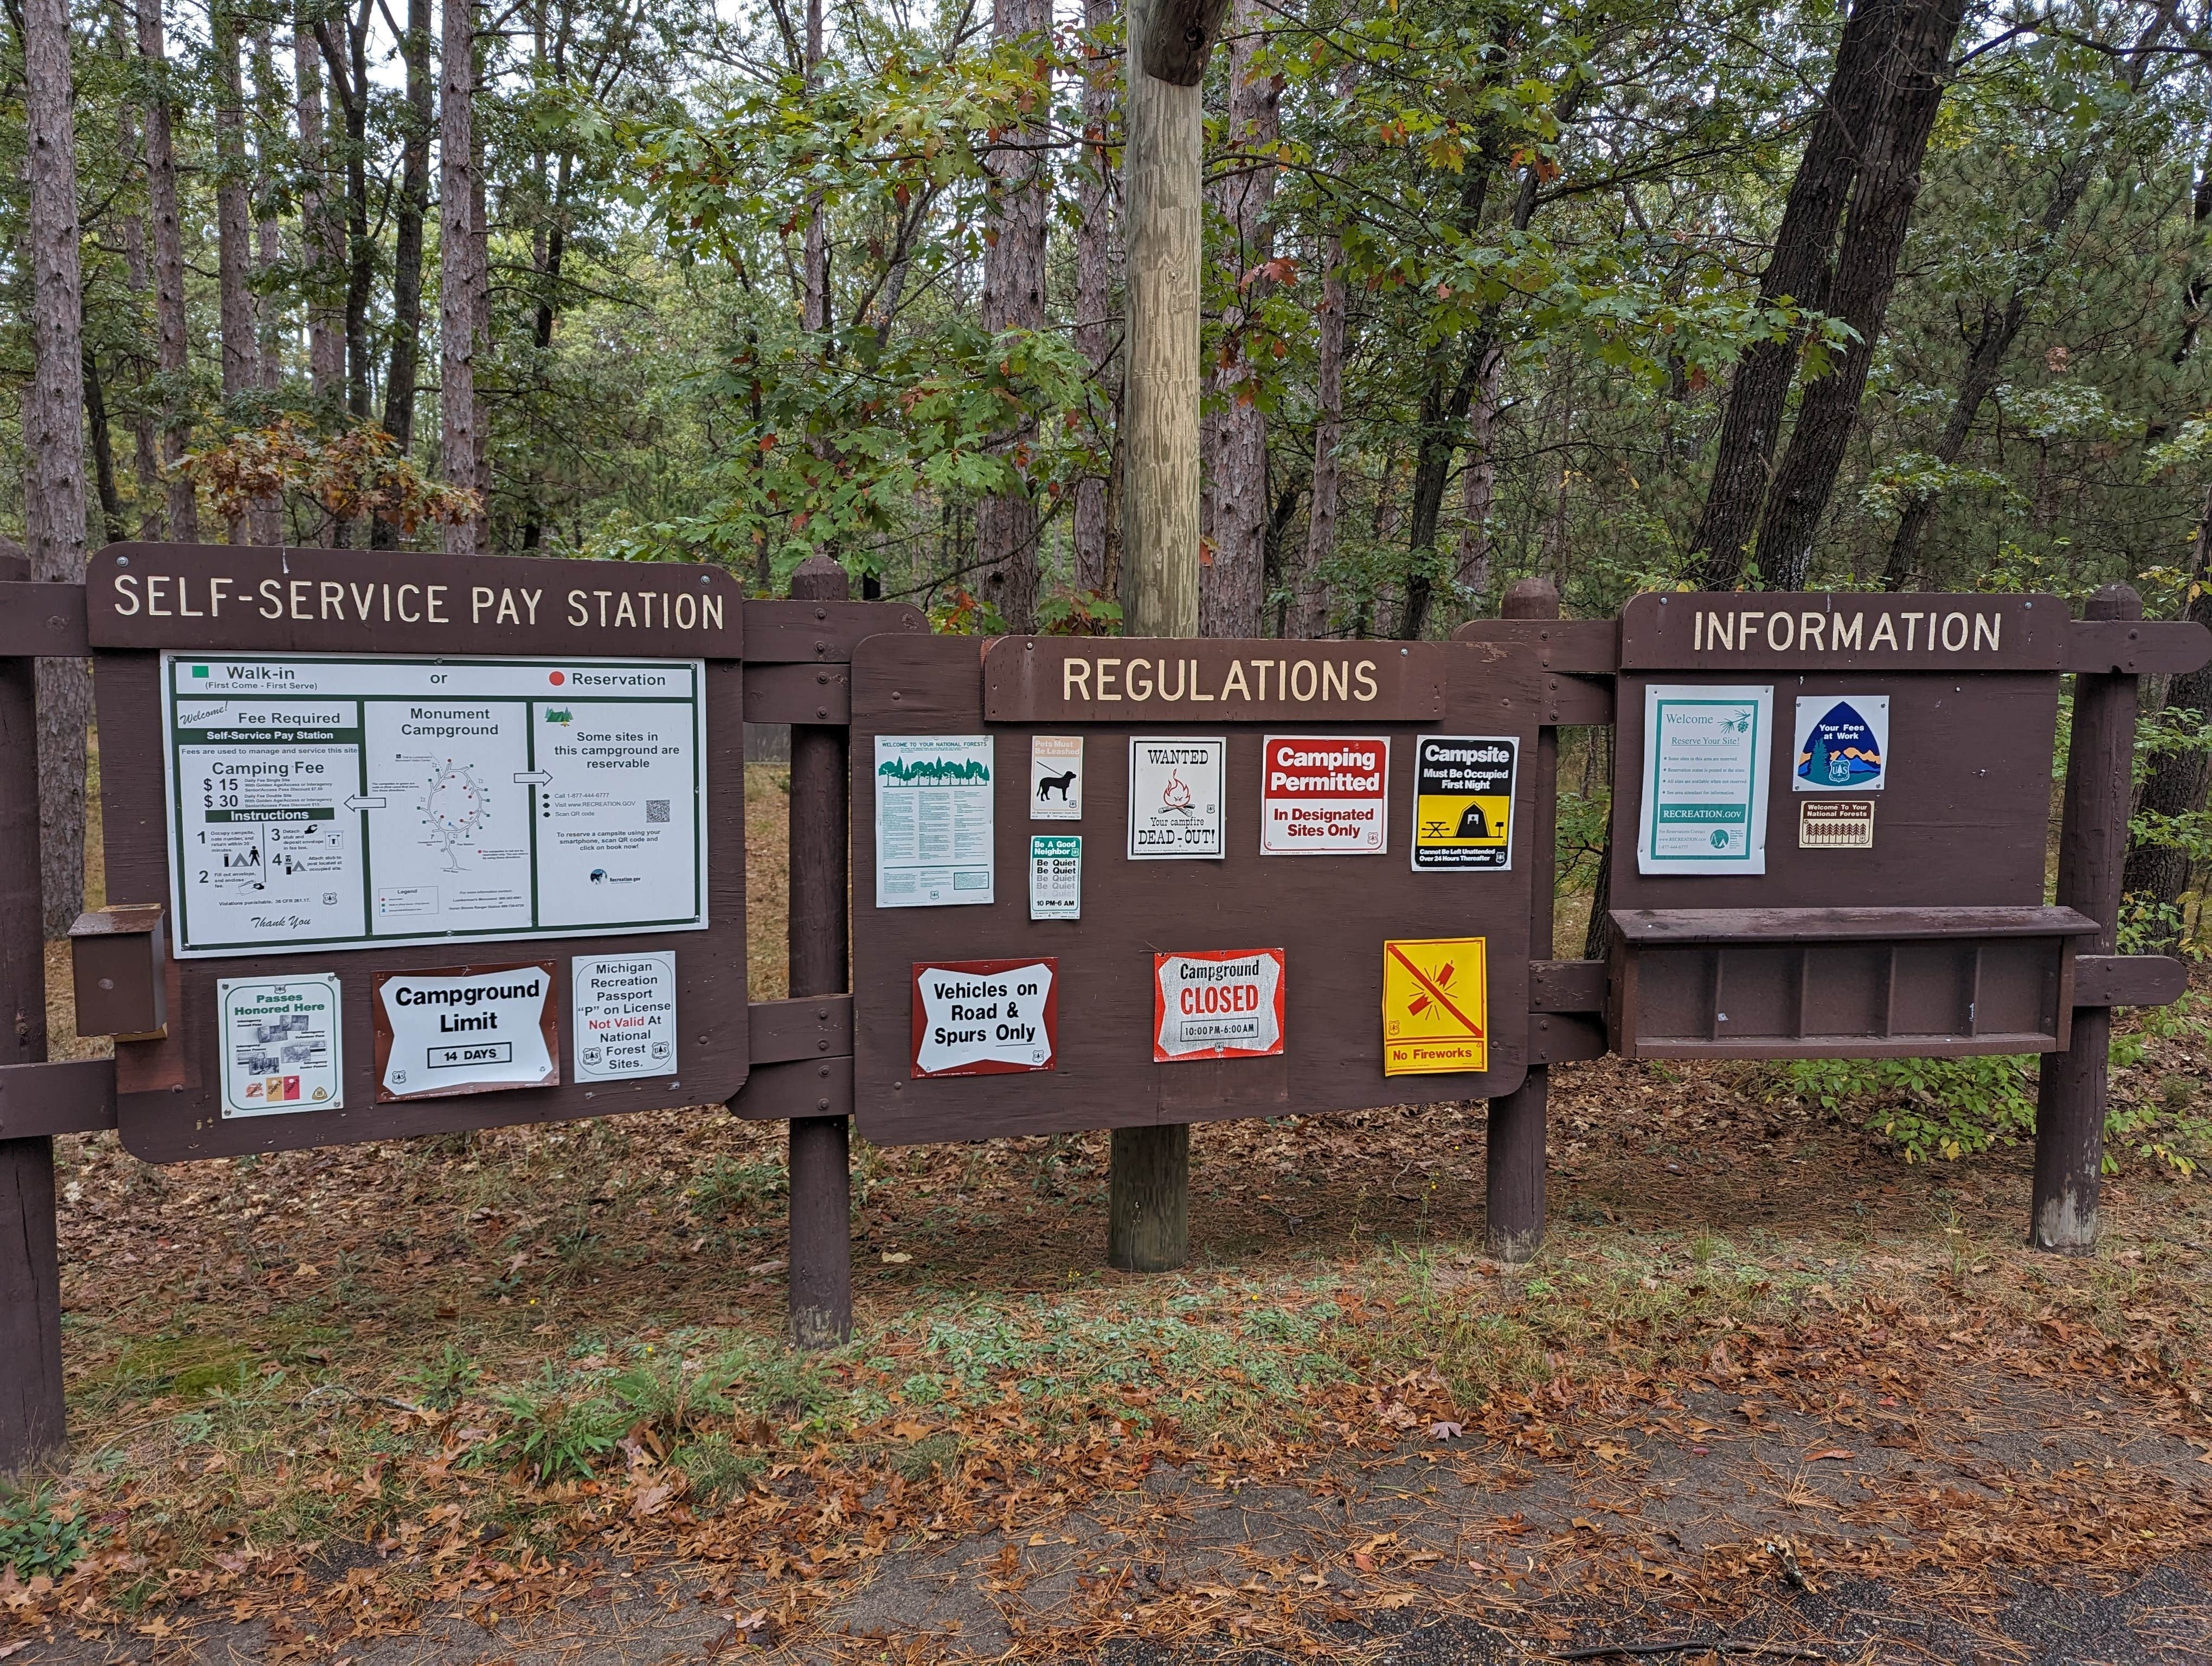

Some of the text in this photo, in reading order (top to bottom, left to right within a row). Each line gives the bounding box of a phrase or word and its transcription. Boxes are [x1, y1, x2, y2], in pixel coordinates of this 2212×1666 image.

[114, 574, 723, 629] SELF-SERVICE PAY STATION
[1695, 611, 2001, 651] INFORMATION
[227, 666, 295, 680] Walk-in
[430, 673, 448, 684] or
[573, 672, 666, 685] Reservation
[1064, 658, 1378, 701] REGULATIONS
[205, 682, 229, 690] (First
[290, 682, 317, 690] Serve)
[180, 701, 228, 725] Welcome!
[239, 713, 340, 726] Fee Required
[410, 707, 490, 720] Monument
[1666, 714, 1713, 724] Welcome
[207, 732, 271, 740] Self-Service
[274, 732, 294, 741] Pay
[401, 723, 499, 738] Campground
[577, 732, 658, 741] Some sites in
[555, 746, 577, 755] this
[582, 745, 658, 757] campground
[1147, 749, 1208, 765] WANTED
[1425, 745, 1510, 764] Campsite
[587, 759, 650, 768] reservable
[1277, 747, 1375, 770] Camping
[212, 761, 324, 777] Camping Fee
[1424, 768, 1508, 780] Must Be Occupied
[203, 778, 238, 792] $ 15
[1270, 772, 1379, 791] Permitted
[1441, 779, 1490, 790] First Night
[204, 794, 238, 809] $ 30
[231, 810, 309, 821] Instructions
[1274, 808, 1374, 823] In Designated
[1150, 817, 1204, 829] Your campfire
[197, 831, 205, 844] 1
[271, 828, 280, 841] 3
[1288, 824, 1360, 839] Sites Only
[1034, 848, 1071, 856] Neighbor
[272, 853, 282, 866] 4
[199, 870, 209, 883] 2
[250, 915, 312, 929] Thank You
[596, 962, 652, 975] Michigan
[1180, 960, 1259, 981] Campground
[591, 975, 658, 988] Recreation
[395, 979, 539, 1006] Campground
[597, 989, 653, 1002] Passport
[934, 982, 1038, 999] Vehicles on
[256, 994, 303, 1003] Passes
[1181, 984, 1258, 1015] CLOSED
[234, 1003, 324, 1015] Honored Here
[604, 1006, 619, 1015] on
[623, 1002, 671, 1014] License
[951, 1002, 1019, 1021] Road &
[440, 1011, 498, 1033] Limit
[589, 1015, 661, 1030] Not Valid At
[934, 1023, 1036, 1047] Spurs Only
[1185, 1024, 1207, 1036] 10:00
[1242, 1023, 1254, 1034] AM
[600, 1030, 651, 1043] National
[444, 1049, 497, 1061] 14 DAYS
[606, 1045, 646, 1056] Forest
[1393, 1047, 1472, 1061] No Fireworks
[609, 1058, 644, 1069] Sites.
